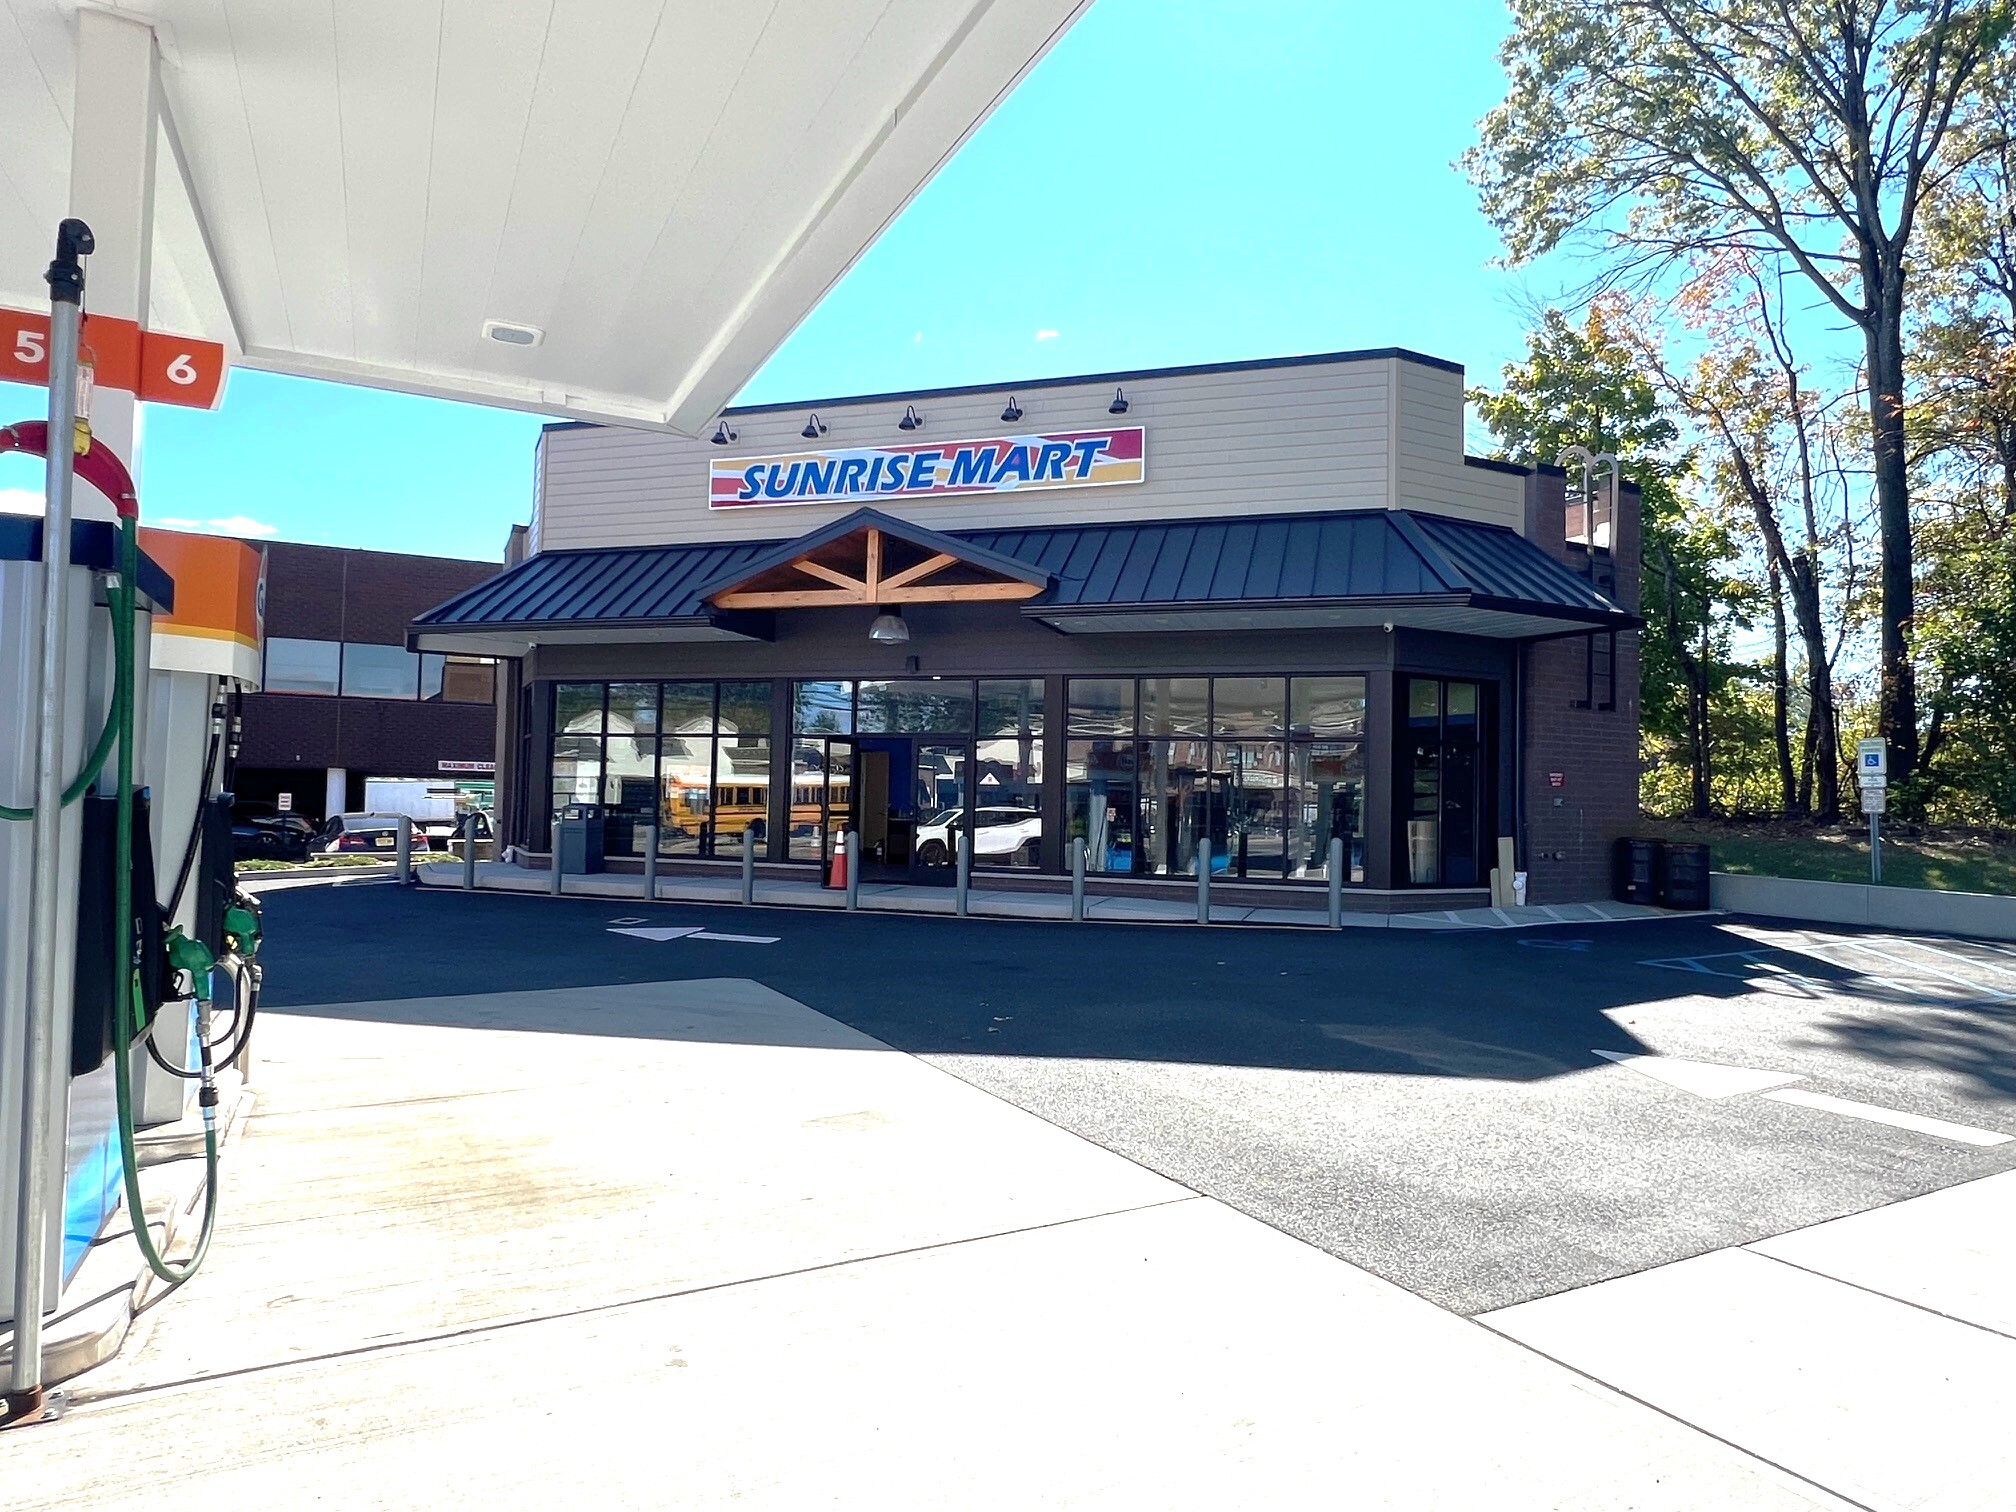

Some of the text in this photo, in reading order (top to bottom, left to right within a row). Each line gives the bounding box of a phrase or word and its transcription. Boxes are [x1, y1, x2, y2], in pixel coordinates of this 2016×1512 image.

[13, 330, 45, 364] 5
[166, 354, 198, 386] 6
[739, 440, 1109, 500] SUNRISE MART
